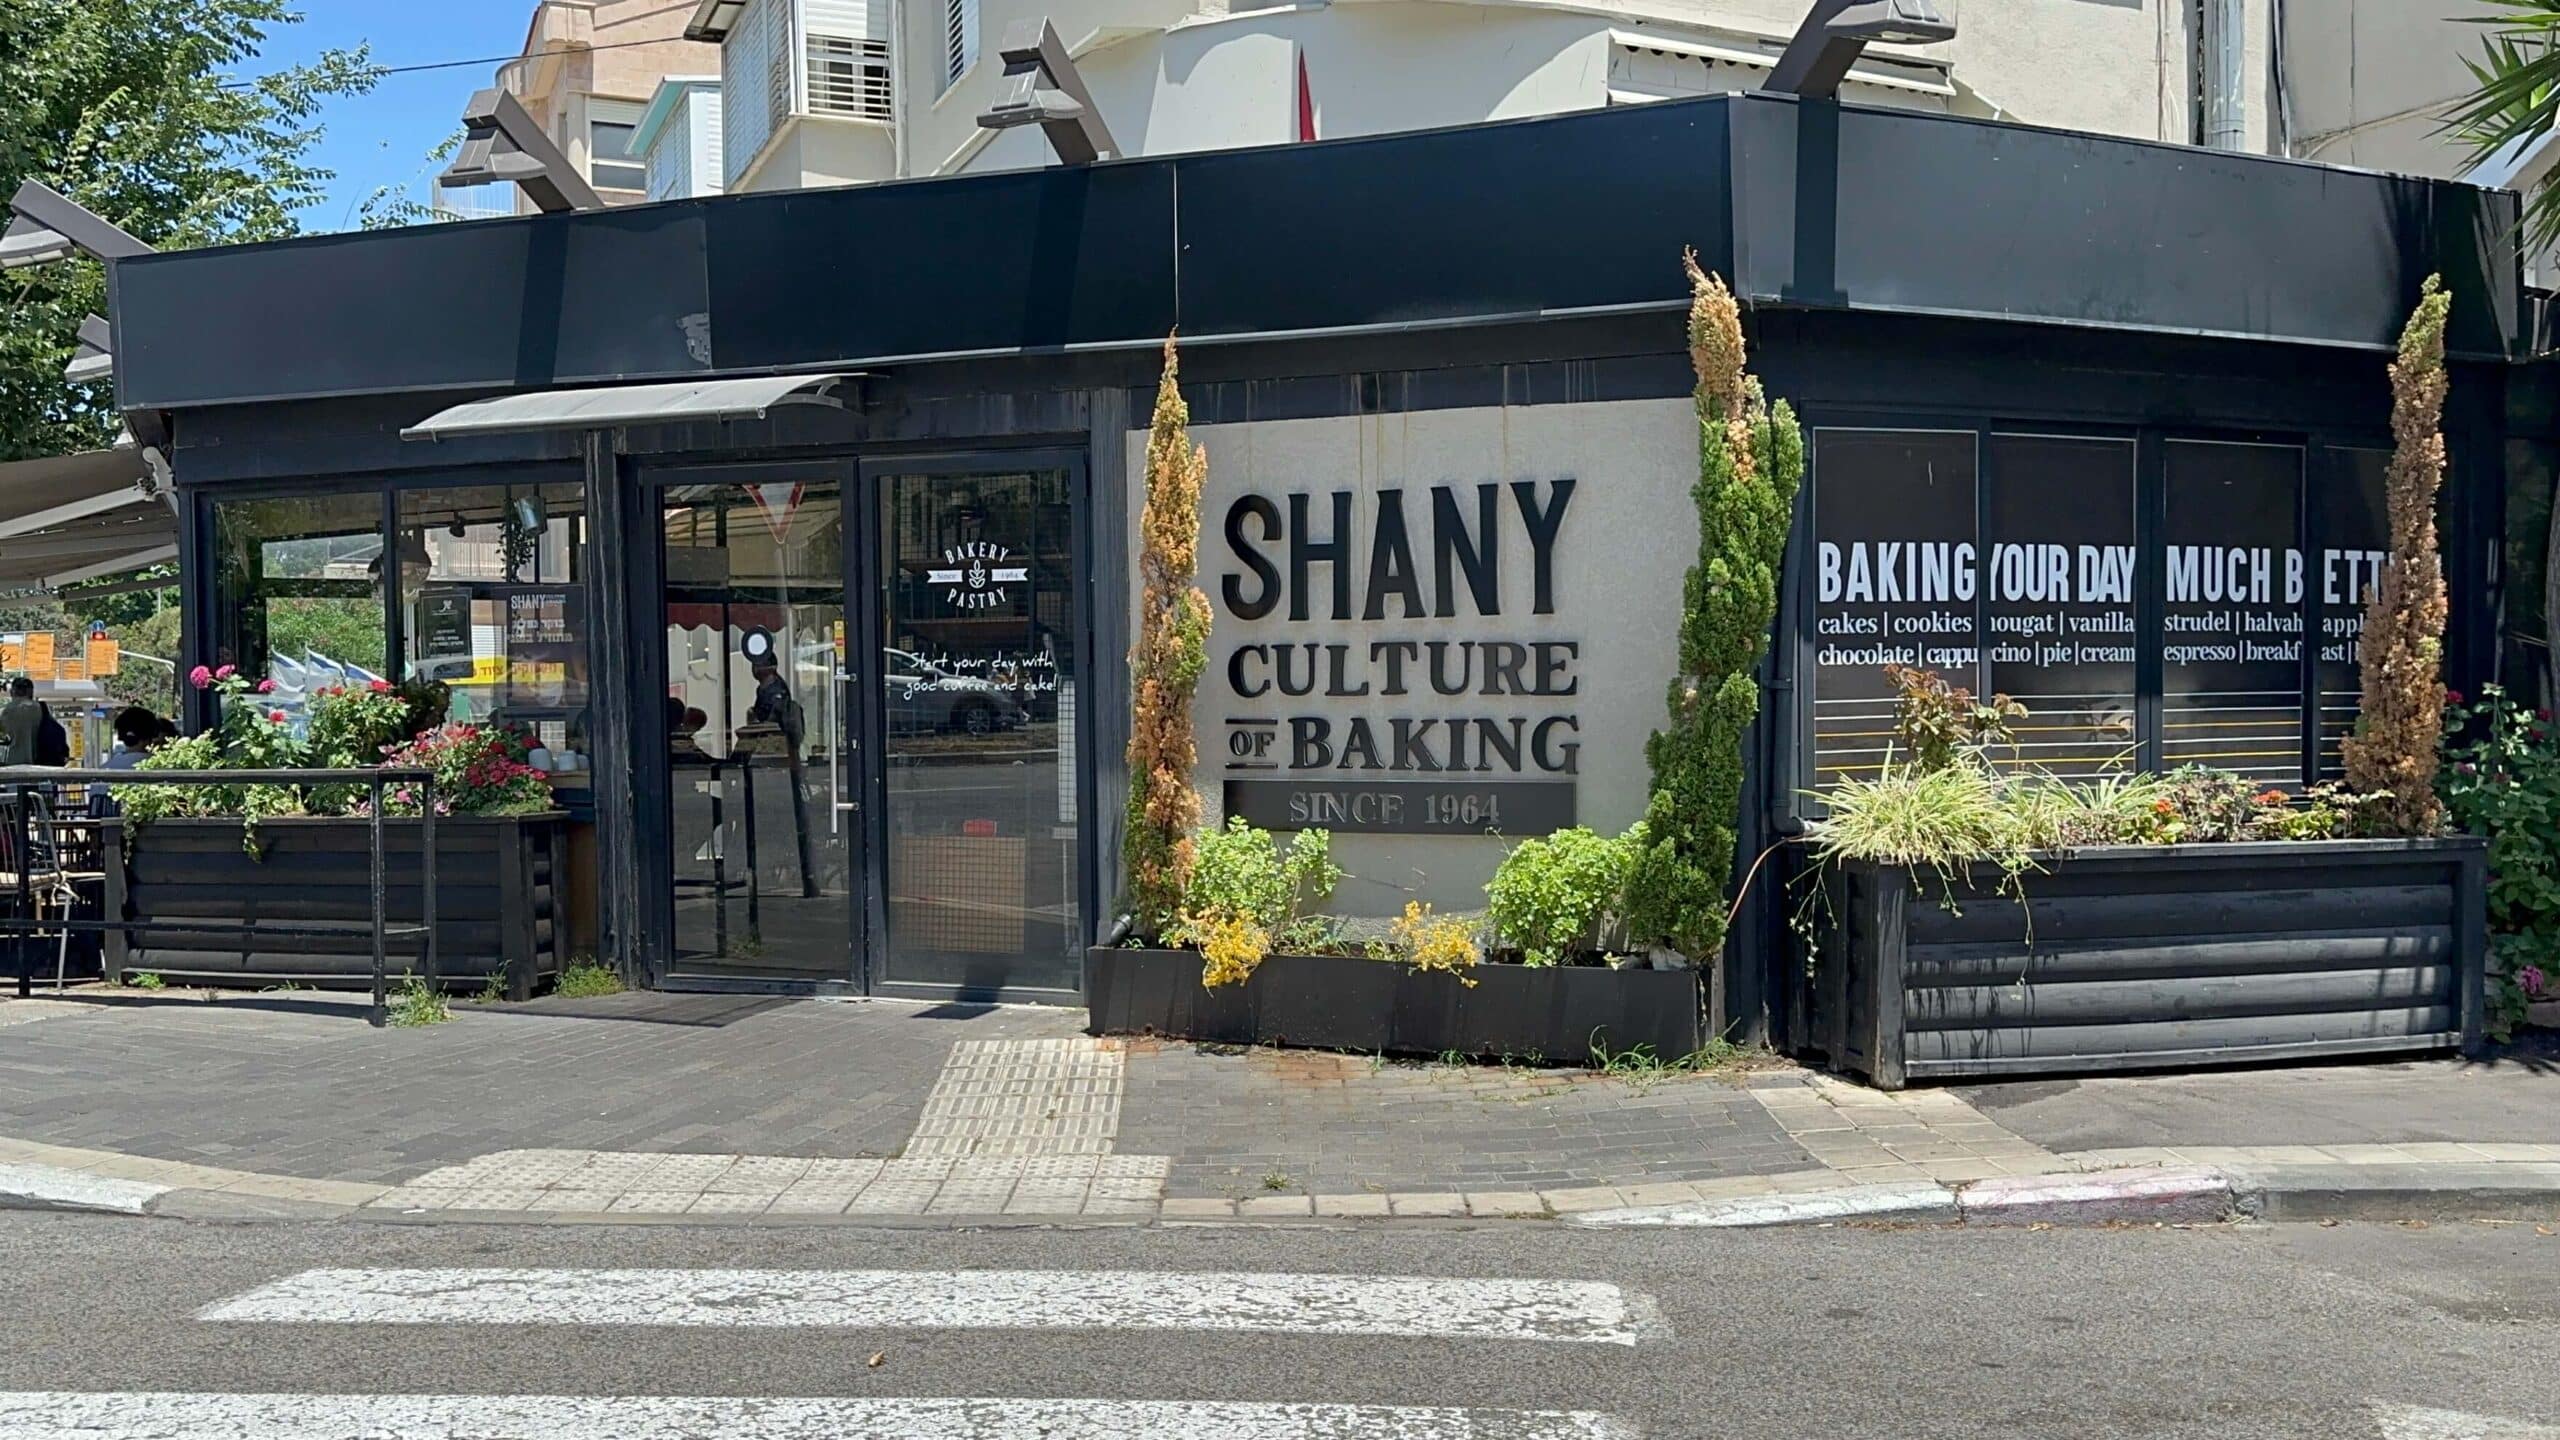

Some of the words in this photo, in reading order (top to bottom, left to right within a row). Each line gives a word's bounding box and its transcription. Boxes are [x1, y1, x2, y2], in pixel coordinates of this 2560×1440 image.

[945, 542, 1009, 565] BAKERY
[1221, 479, 1577, 621] SHANY
[1818, 541, 1975, 602] BAKING
[1990, 543, 2070, 602] YOUR
[2078, 545, 2136, 603] DAY
[2166, 545, 2271, 603] MUCH
[510, 594, 546, 609] SHANY
[947, 587, 1006, 609] PASTRY
[1818, 612, 1878, 634] cakes
[1894, 611, 1972, 633] cookies
[2069, 611, 2136, 633] vanilla
[2164, 611, 2231, 632] strudel
[2244, 611, 2304, 632] halvah
[910, 651, 949, 668] Start
[953, 658, 986, 676] your
[991, 650, 1018, 677] day
[1022, 650, 1053, 667] with
[1818, 643, 1914, 666] chocolate
[2043, 641, 2072, 667] pie
[2081, 646, 2136, 662] cream
[2163, 645, 2237, 665] espresso
[1227, 641, 1579, 698] CULTURE
[903, 674, 938, 700] good
[943, 675, 988, 691] coffee
[994, 673, 1018, 691] and
[1023, 673, 1058, 691] cake!
[1229, 729, 1275, 758] OF
[1288, 715, 1581, 775] BAKING
[1289, 791, 1405, 825] SINCE
[1424, 793, 1500, 825] 1964
